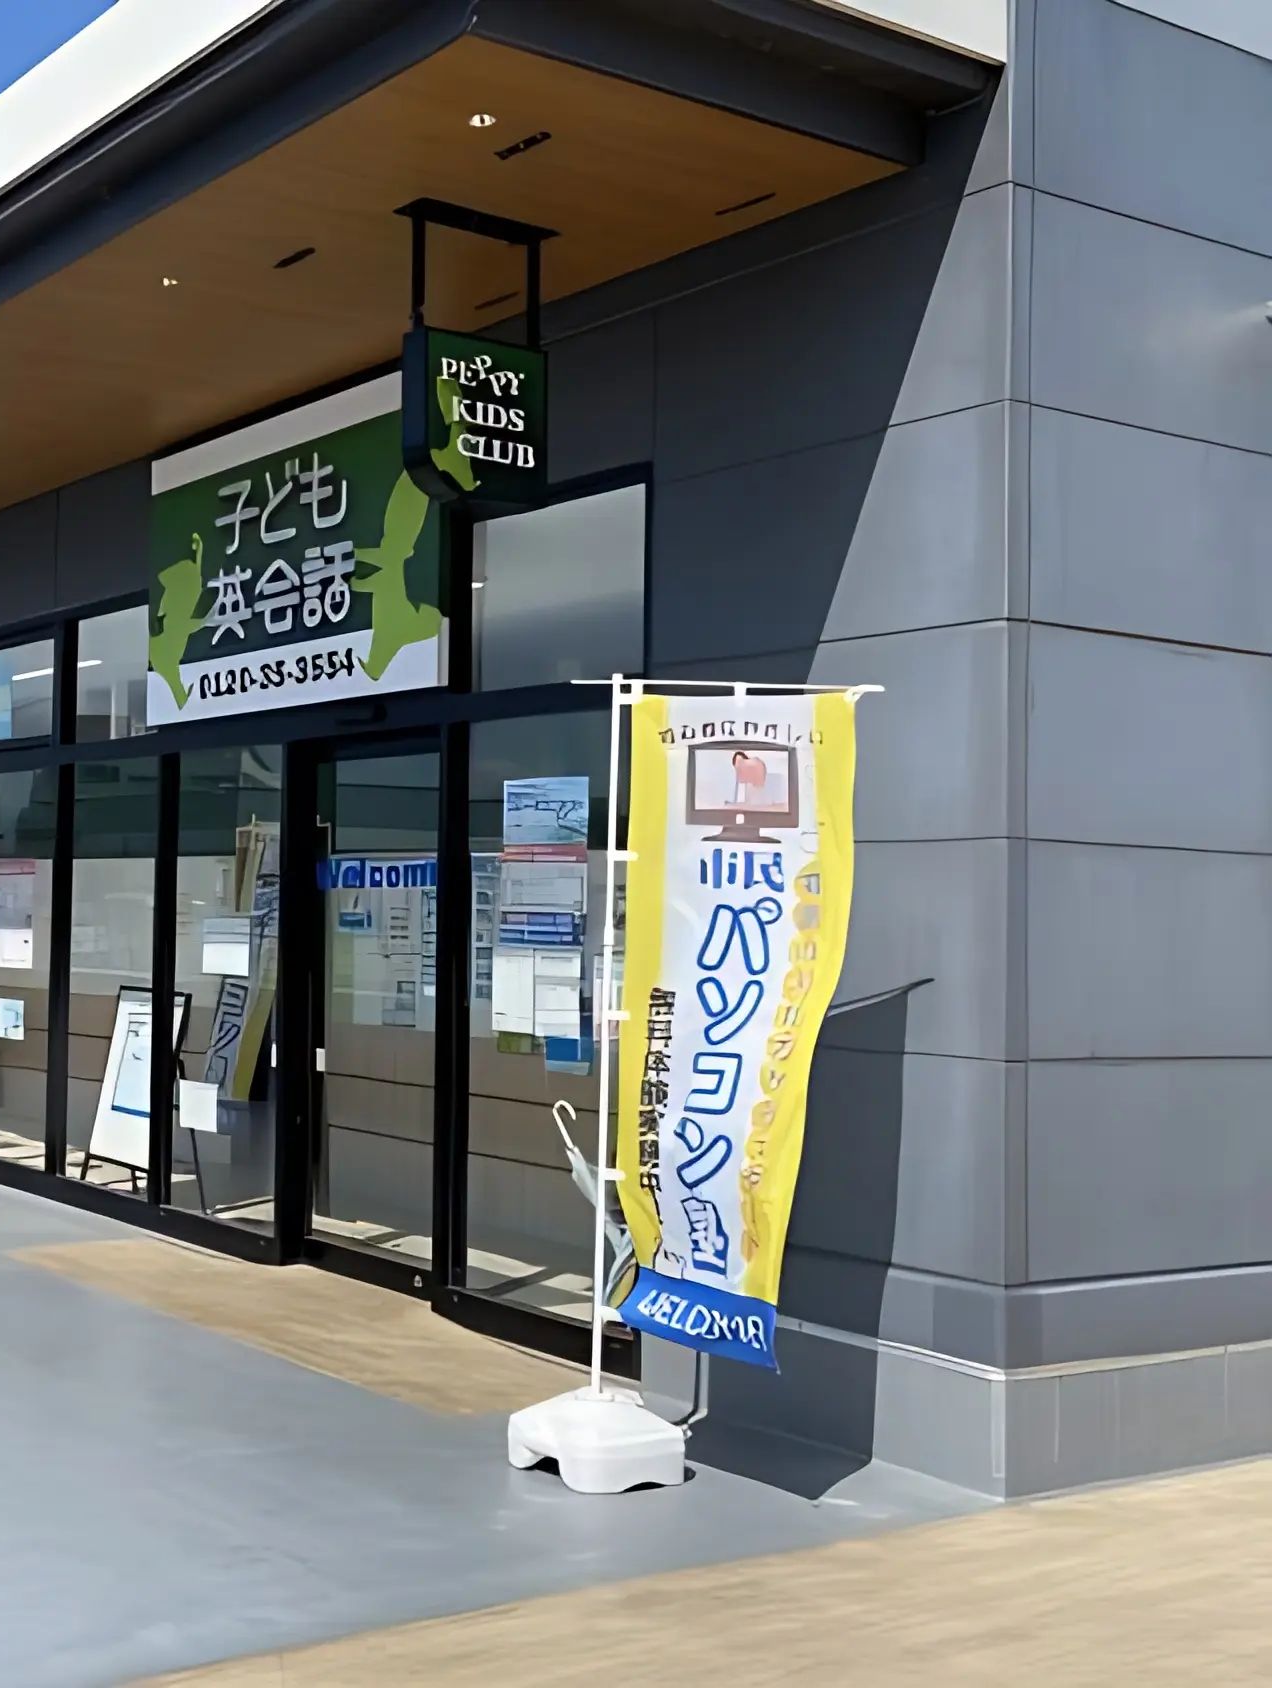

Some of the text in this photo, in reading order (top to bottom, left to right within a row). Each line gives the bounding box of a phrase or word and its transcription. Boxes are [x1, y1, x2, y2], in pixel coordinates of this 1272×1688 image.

[452, 396, 526, 432] KIDS
[456, 433, 536, 469] CLUB
[214, 451, 348, 555] 子ども
[205, 540, 357, 647] 英会話
